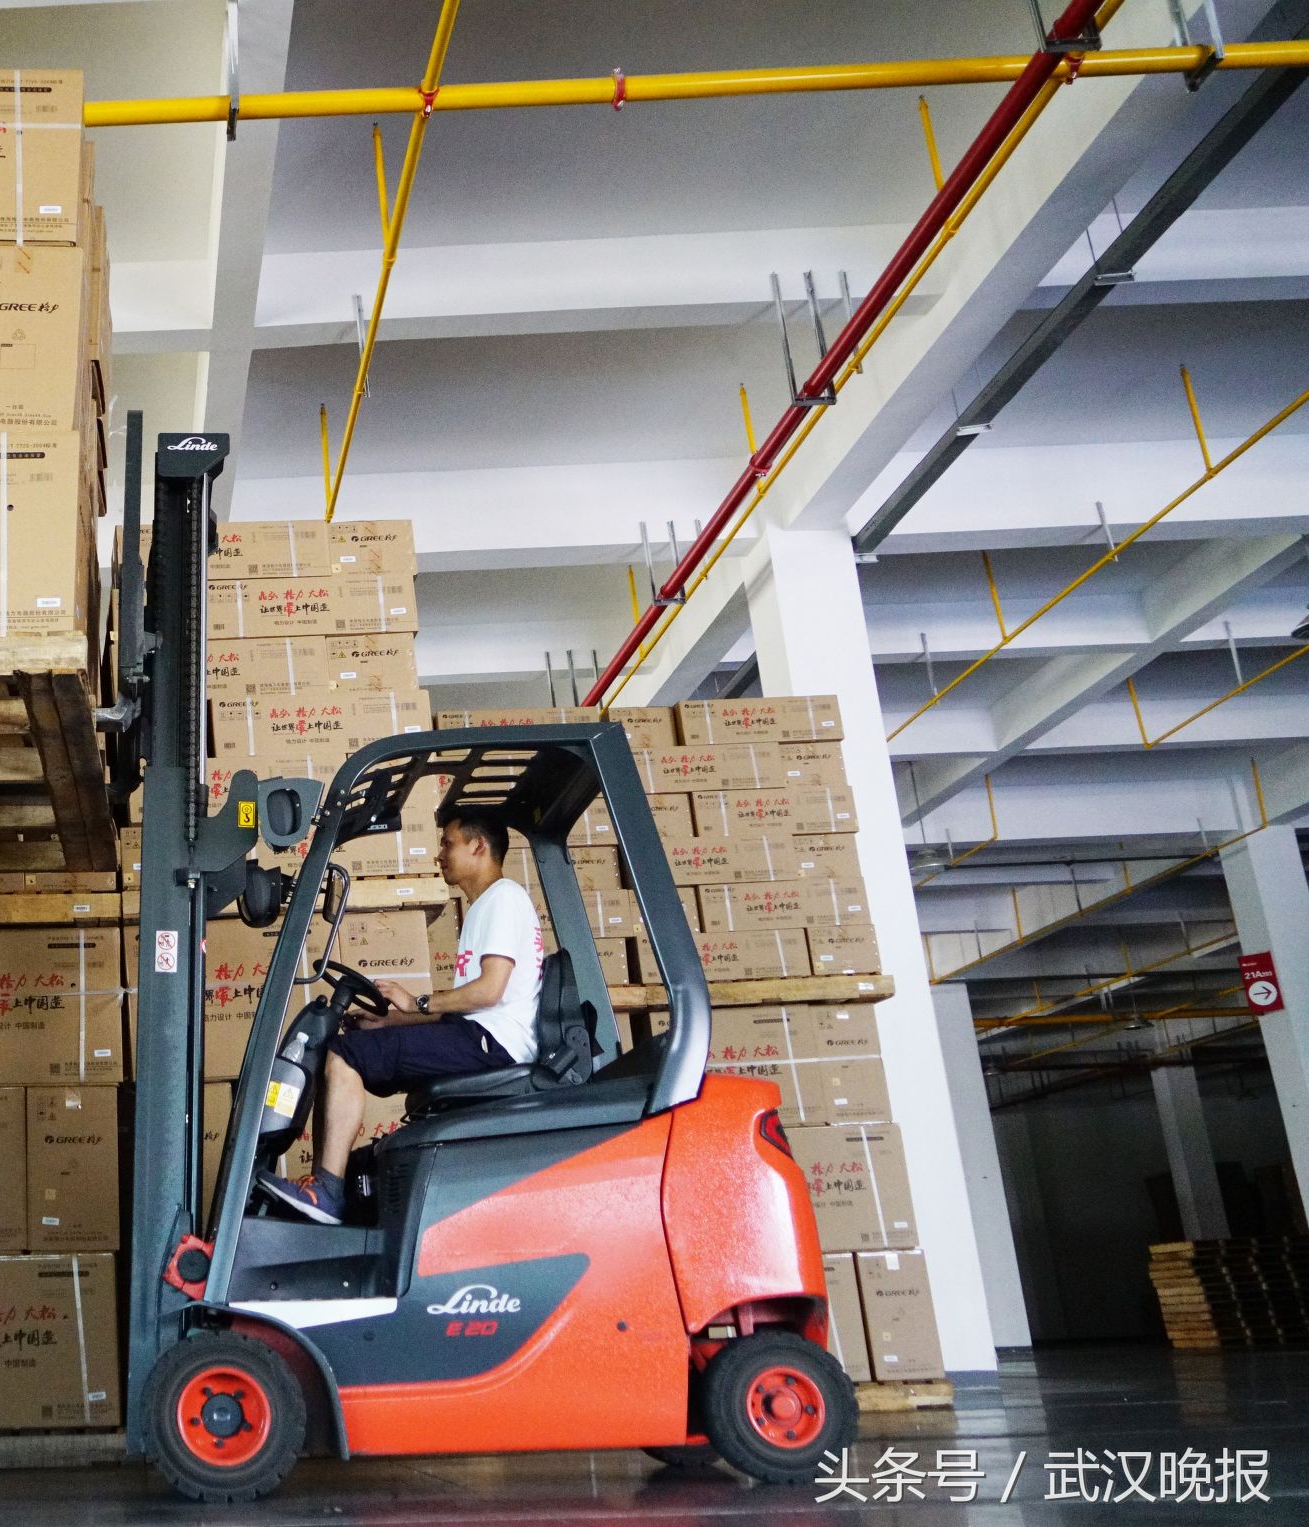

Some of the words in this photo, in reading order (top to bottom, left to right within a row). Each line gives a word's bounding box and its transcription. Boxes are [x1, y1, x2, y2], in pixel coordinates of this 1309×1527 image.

[167, 436, 218, 451] Linde
[427, 1284, 521, 1314] Linde
[446, 1322, 463, 1336] E
[465, 1320, 498, 1336] 20
